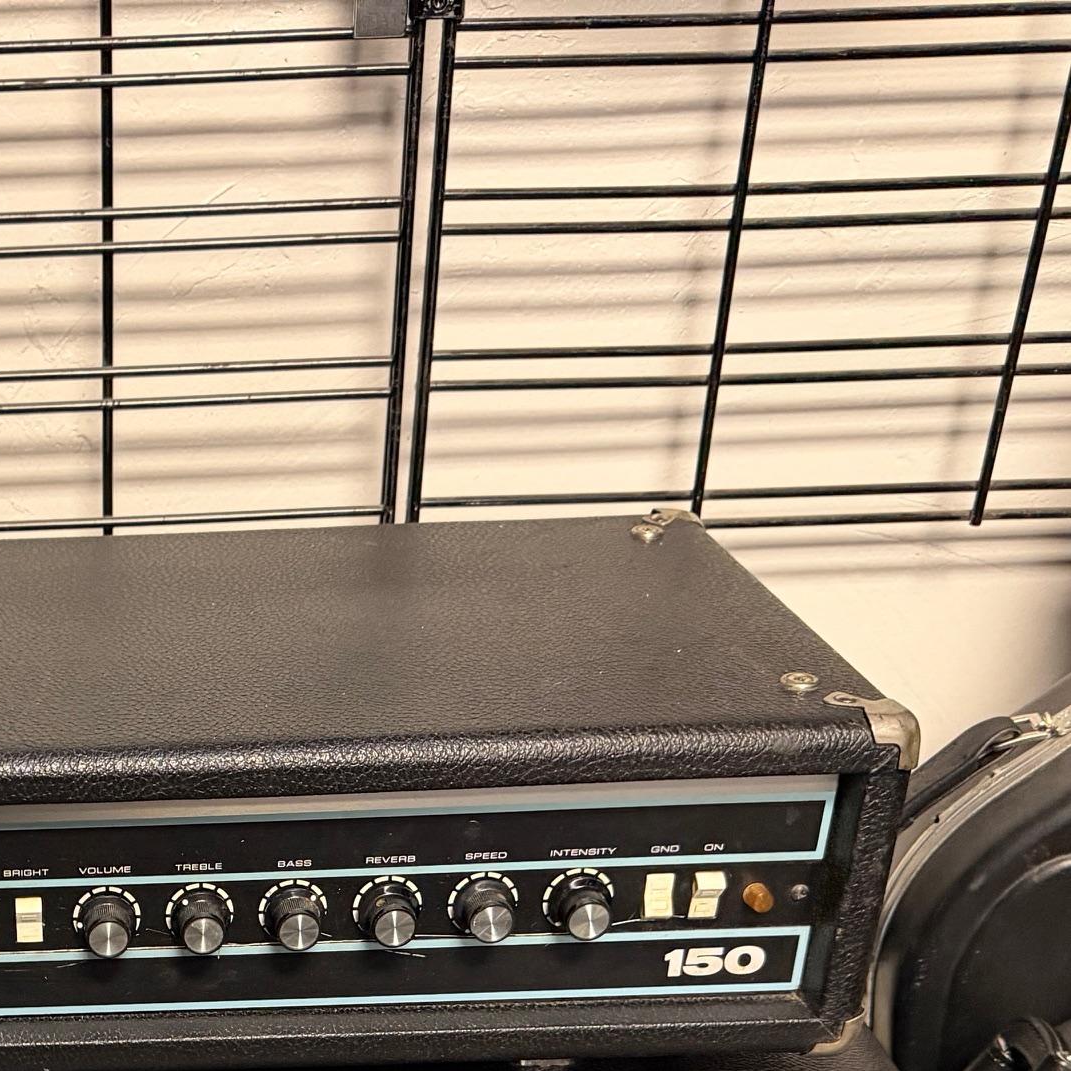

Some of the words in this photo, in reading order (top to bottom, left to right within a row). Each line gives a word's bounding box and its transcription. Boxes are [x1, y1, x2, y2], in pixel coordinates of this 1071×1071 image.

[549, 846, 618, 857] INTENSITY
[650, 844, 680, 854] GND
[703, 843, 725, 852] ON
[365, 854, 416, 865] REVERB
[464, 850, 508, 861] SPEED
[175, 862, 223, 872] TREBLE
[277, 859, 312, 868] BASS
[3, 868, 49, 878] BRIGHT
[78, 865, 132, 876] VOLUME
[663, 945, 766, 978] 150
